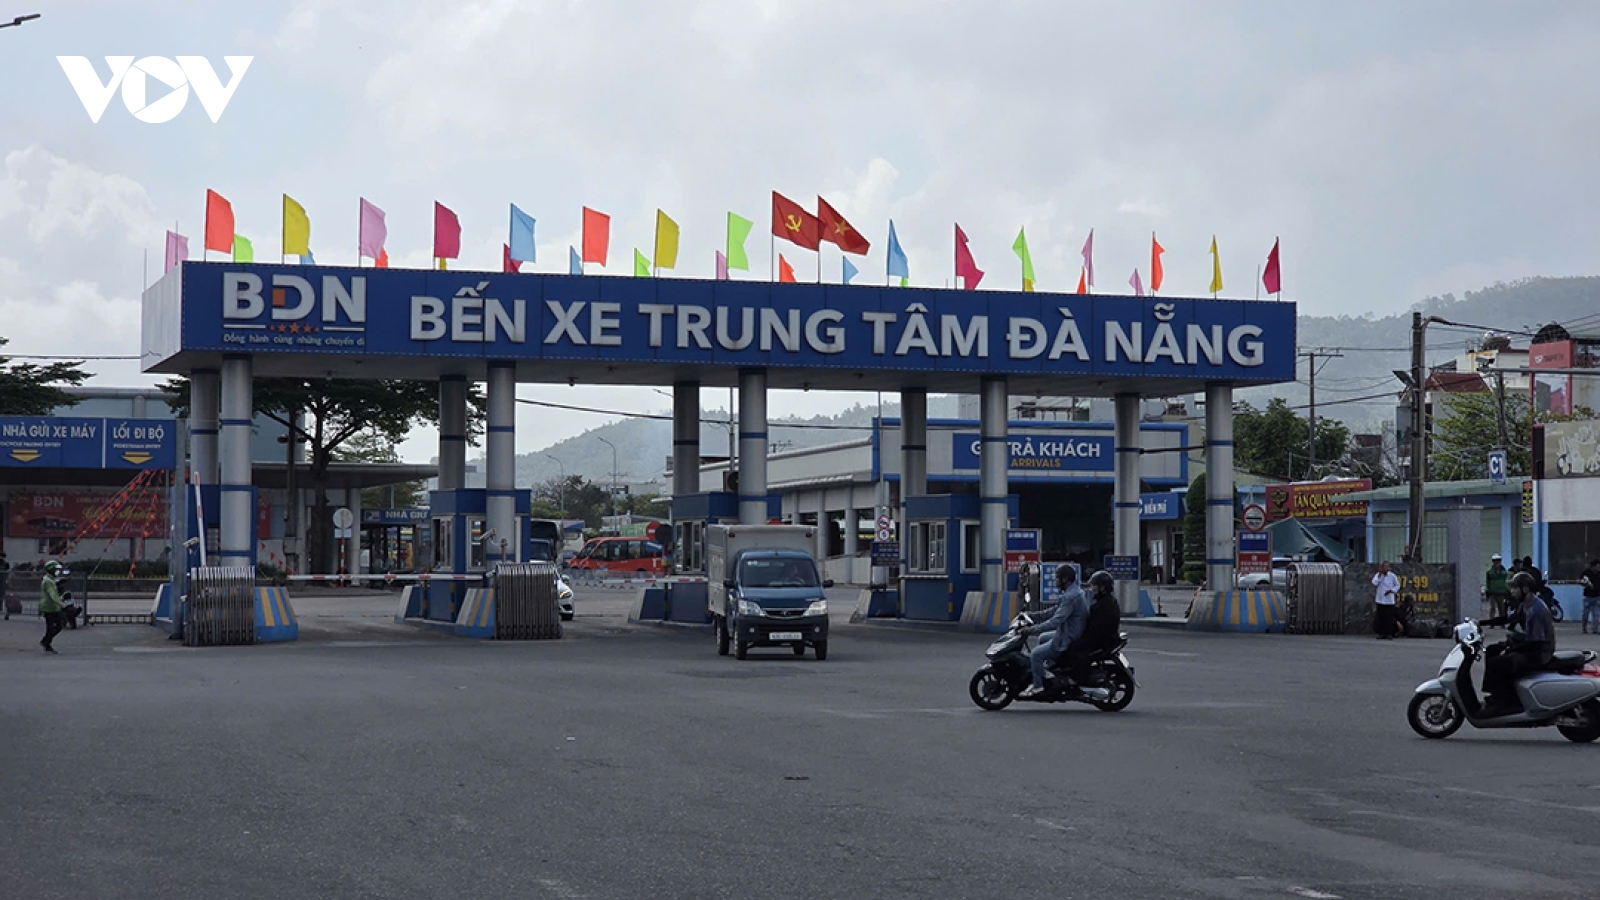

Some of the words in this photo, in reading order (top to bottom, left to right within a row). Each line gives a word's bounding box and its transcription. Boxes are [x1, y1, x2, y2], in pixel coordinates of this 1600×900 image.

[222, 271, 367, 323] BDN
[410, 282, 525, 342] BẾN
[544, 300, 622, 345] XE
[638, 303, 845, 354] TRUNG
[863, 302, 988, 357] TÂM
[1005, 307, 1090, 360] ĐÀ
[1105, 303, 1264, 366] NẴNG
[273, 336, 293, 345] cùng
[2, 422, 28, 437] NHÀ
[53, 426, 68, 438] XE
[70, 422, 97, 439] MÁY
[113, 421, 130, 439] LỐI
[133, 426, 146, 439] ĐI
[148, 424, 165, 442] BỘ
[1039, 438, 1101, 458] KHÁCH
[1010, 458, 1061, 468] ARRIVALS
[1490, 456, 1503, 474] C1
[33, 496, 65, 507] BDN
